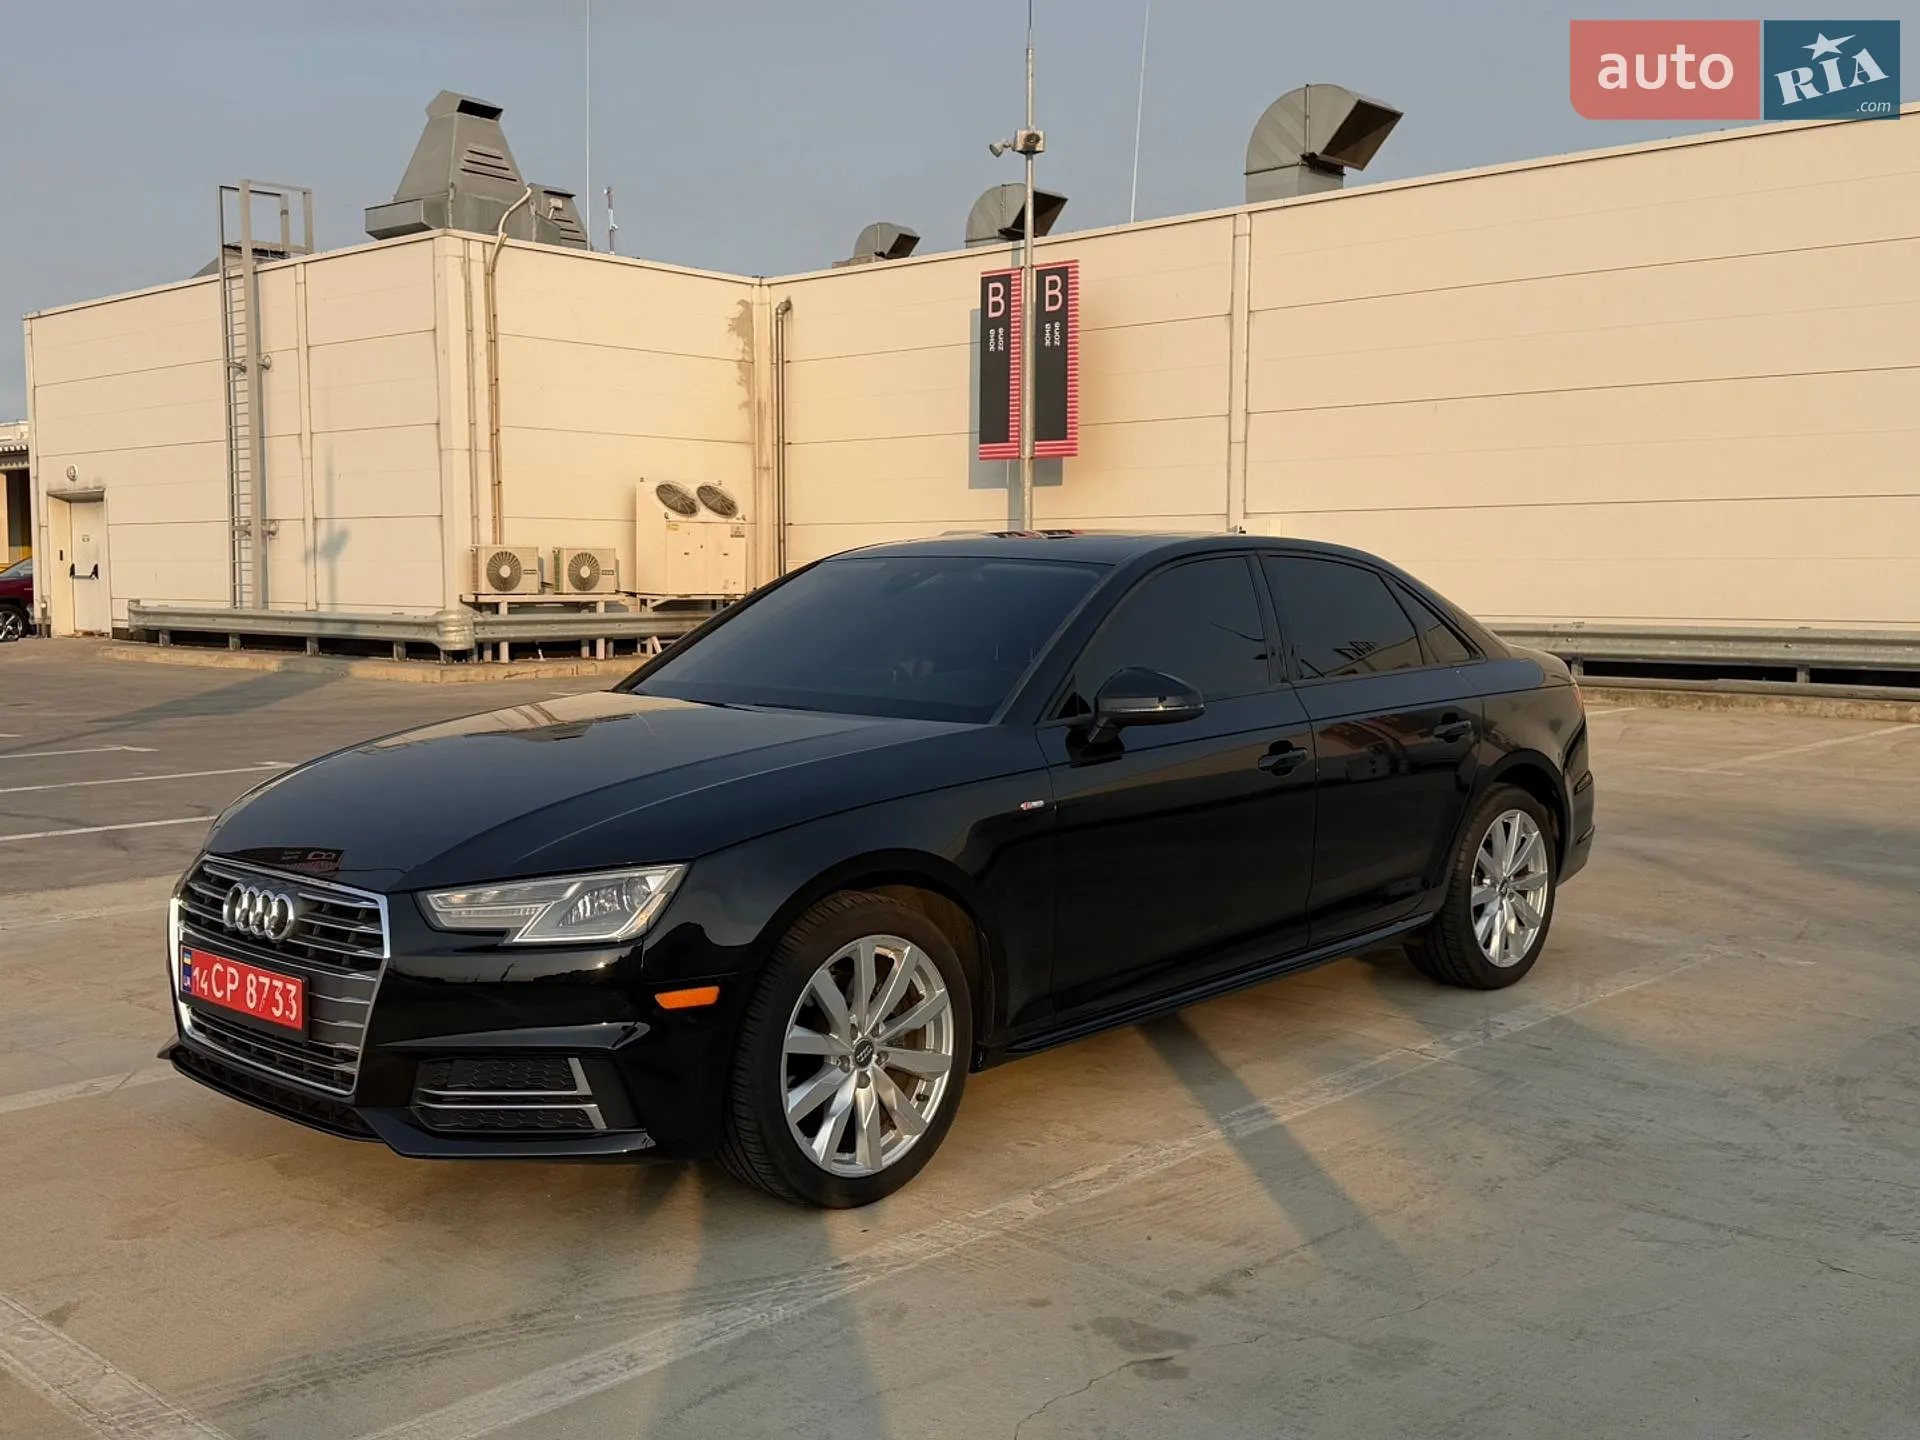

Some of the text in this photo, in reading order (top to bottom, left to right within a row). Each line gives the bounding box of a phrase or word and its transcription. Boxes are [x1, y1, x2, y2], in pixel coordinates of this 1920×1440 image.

[987, 282, 1006, 319] B
[1044, 274, 1064, 313] B
[246, 972, 298, 1021] 8733
